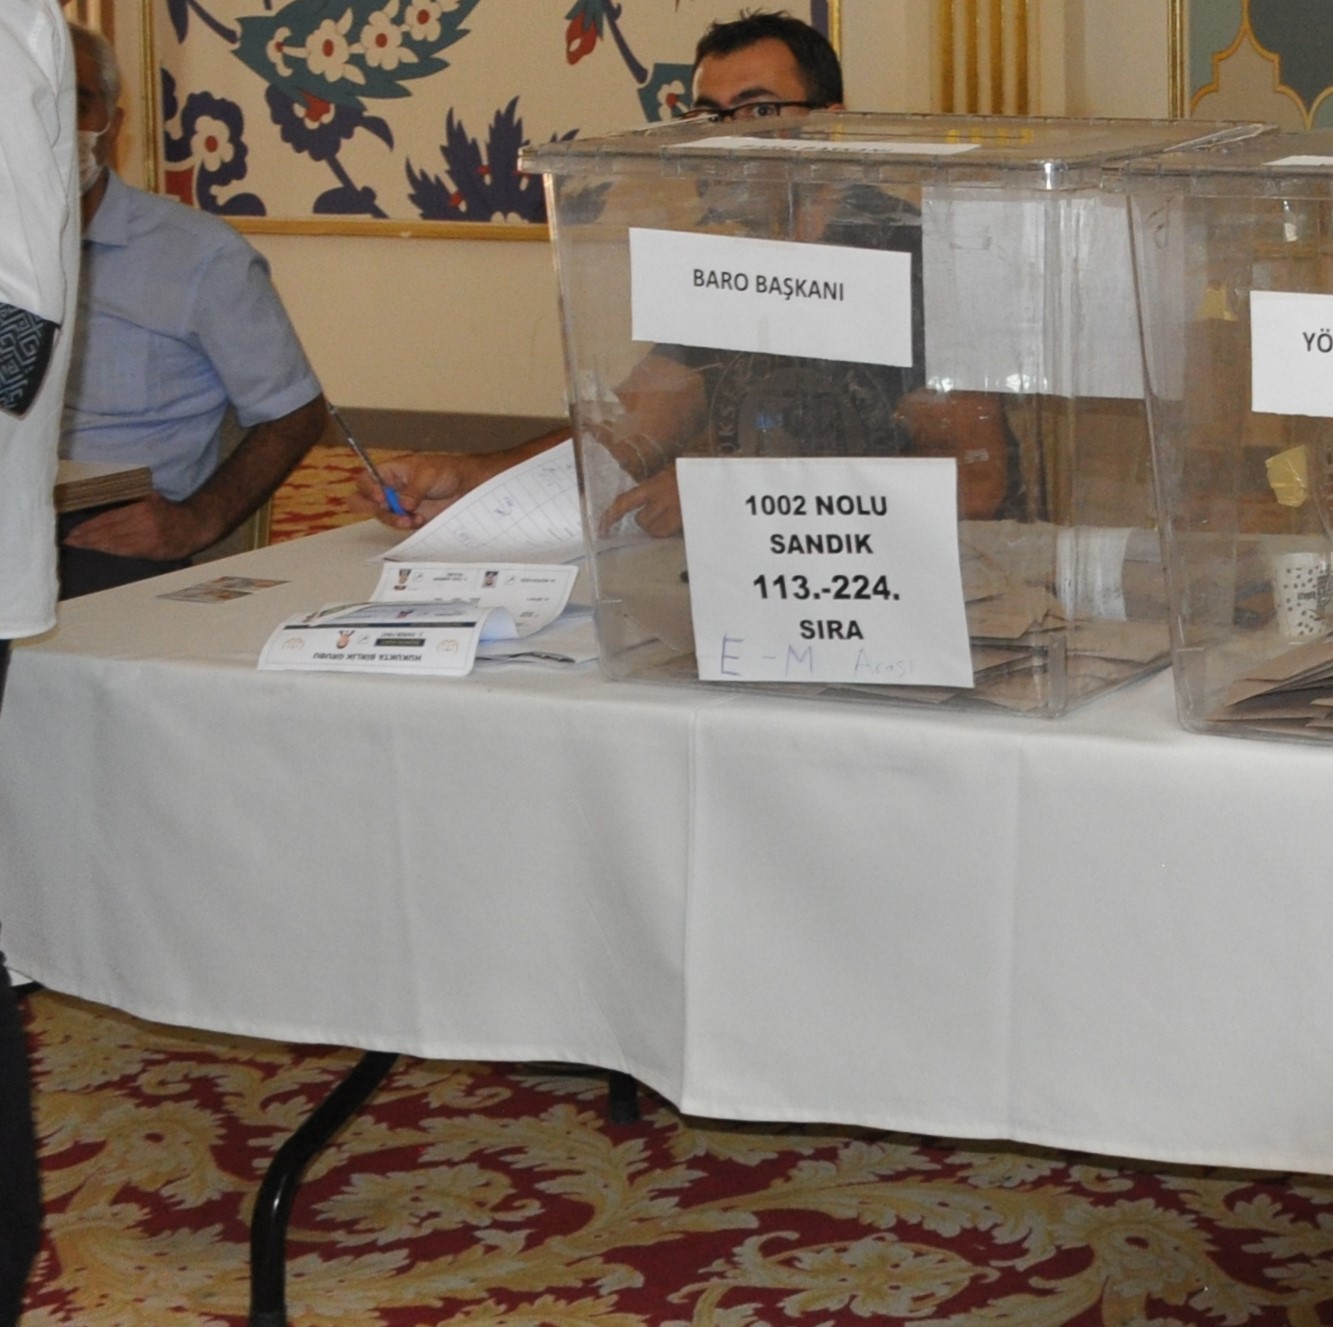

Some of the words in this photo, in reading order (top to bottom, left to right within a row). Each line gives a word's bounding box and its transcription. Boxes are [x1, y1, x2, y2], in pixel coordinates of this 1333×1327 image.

[693, 268, 749, 292] BARO
[755, 274, 844, 302] BAŞKANI
[745, 494, 808, 516] 1002
[815, 494, 888, 517] NOLU
[769, 533, 874, 555] SANDIK
[753, 574, 901, 601] 113.-224.
[799, 619, 865, 640] SIRA
[720, 633, 745, 677] E
[784, 643, 814, 678] M
